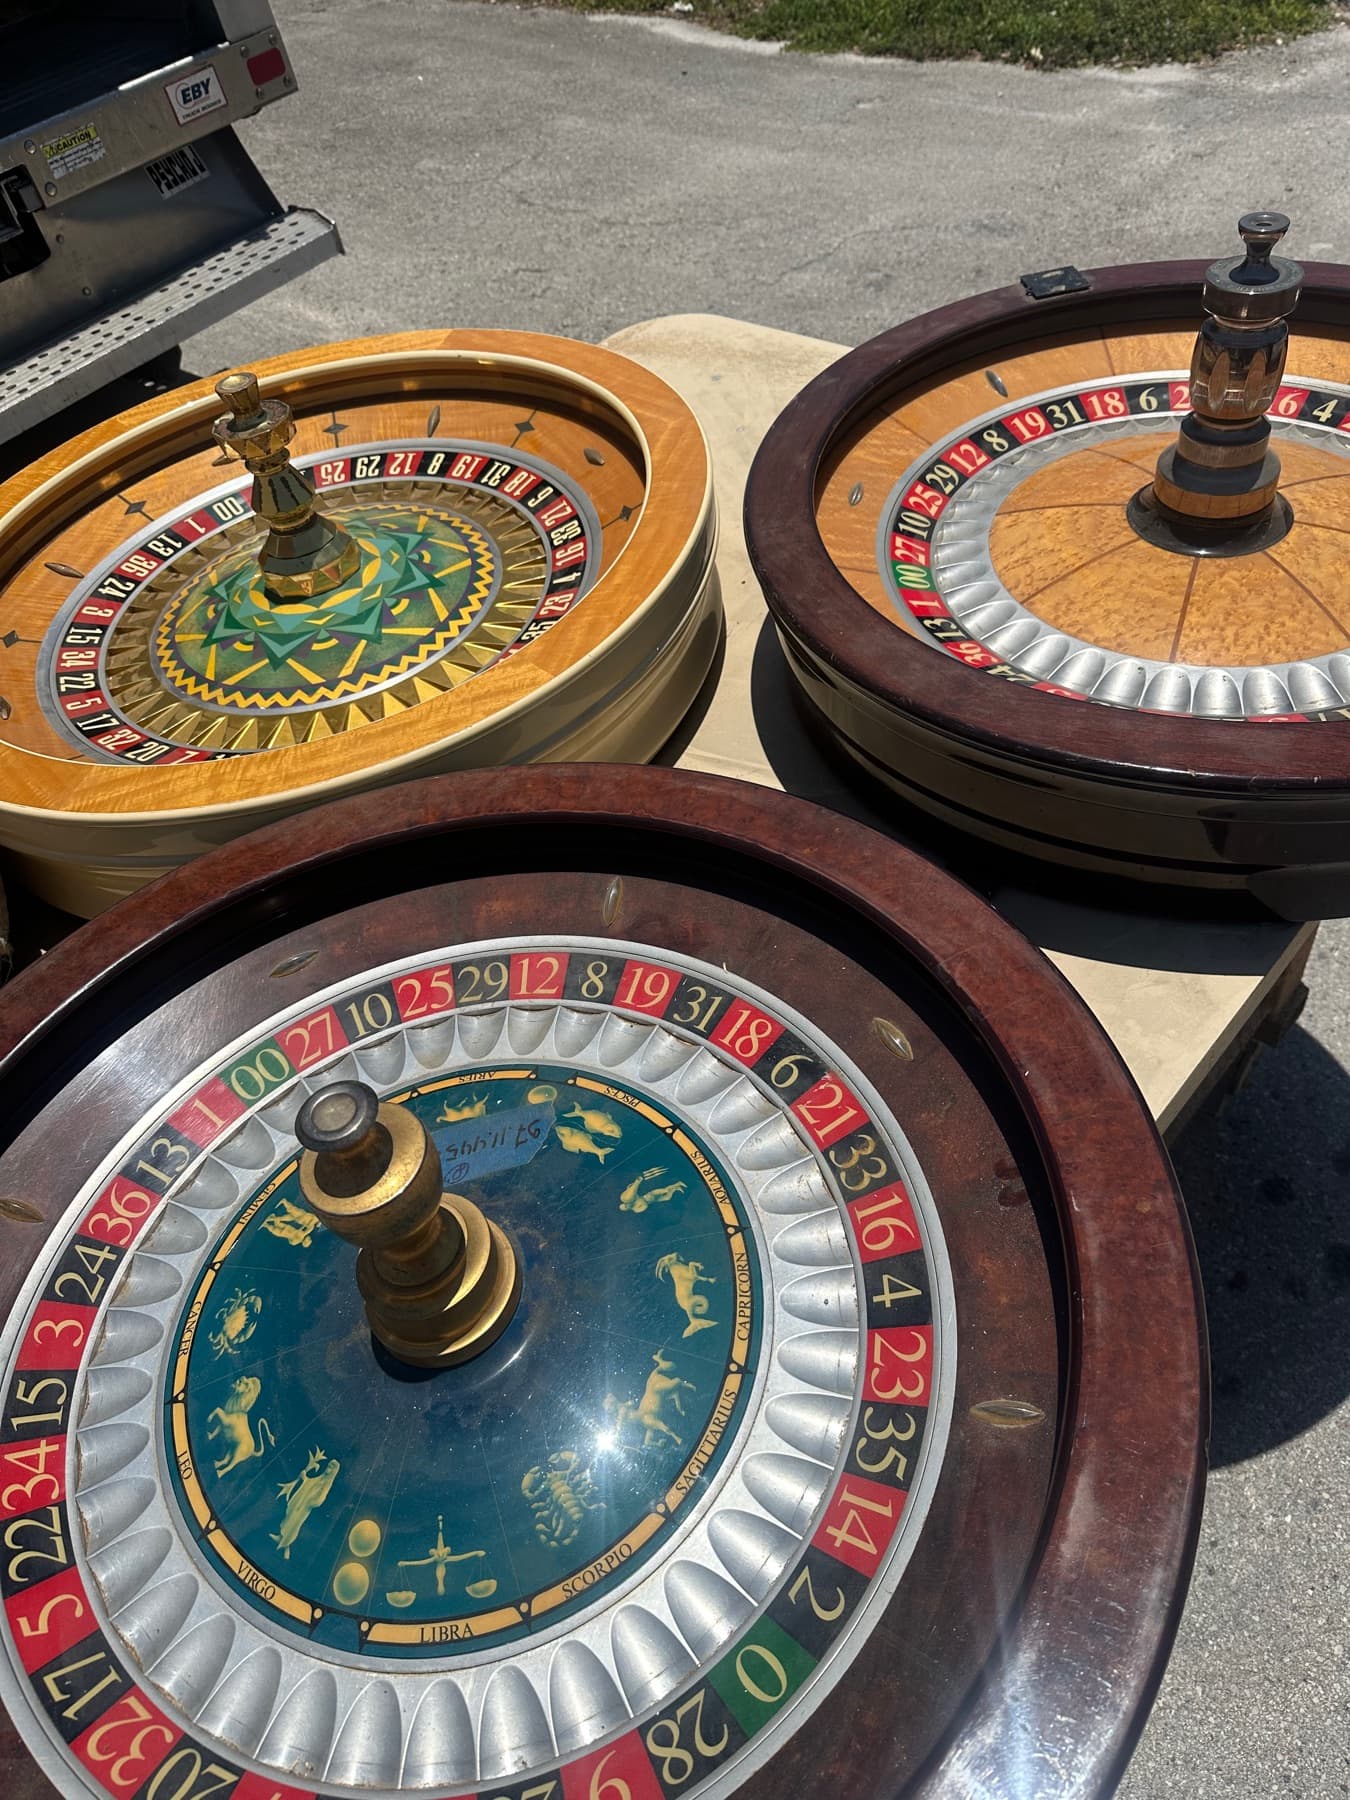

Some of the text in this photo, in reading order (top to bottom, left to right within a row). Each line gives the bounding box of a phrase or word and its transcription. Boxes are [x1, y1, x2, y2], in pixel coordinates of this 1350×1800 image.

[181, 77, 210, 105] EBY
[56, 131, 91, 151] CAUTION
[1087, 391, 1125, 419] 18
[1139, 387, 1158, 412] 6
[1173, 385, 1190, 410] 2
[1312, 400, 1338, 422] 4
[1010, 411, 1046, 441] 19
[1046, 400, 1087, 429] 31
[982, 429, 1009, 451] 8
[321, 461, 345, 485] 25
[355, 455, 381, 478] 29
[389, 453, 417, 475] 12
[427, 453, 446, 475] 8
[452, 455, 482, 479] 19
[950, 445, 988, 473] 12
[480, 461, 511, 487] 31
[504, 470, 537, 497] 18
[925, 464, 959, 495] 29
[212, 496, 244, 521] 00
[528, 486, 554, 508] 6
[908, 484, 943, 517] 25
[184, 516, 206, 534] 1
[541, 500, 573, 527] 21
[898, 512, 931, 540] 10
[148, 533, 182, 557] 13
[550, 520, 581, 546] 33
[556, 542, 584, 566] 16
[894, 536, 926, 566] 27
[120, 555, 158, 577] 36
[553, 572, 581, 584] 4
[896, 564, 930, 588] 00
[98, 577, 136, 599] 24
[81, 606, 114, 617] 3
[540, 593, 575, 615] 23
[908, 599, 942, 610] 1
[66, 627, 103, 644] 15
[923, 617, 967, 640] 13
[60, 651, 96, 667] 34
[947, 642, 999, 667] 36
[59, 673, 95, 692] 22
[66, 697, 103, 711] 5
[76, 713, 120, 731] 17
[97, 729, 141, 751] 32
[125, 742, 170, 762] 20
[457, 962, 509, 1003] 29
[514, 957, 560, 996] 12
[581, 961, 608, 998] 8
[621, 967, 670, 1008] 19
[398, 969, 454, 1018] 25
[346, 993, 393, 1038] 10
[673, 986, 722, 1033] 31
[285, 1012, 334, 1068] 27
[719, 1009, 772, 1058] 18
[231, 1048, 290, 1100] 00
[458, 1071, 497, 1085] ARIES
[770, 1054, 814, 1088] 6
[603, 1086, 641, 1107] PISCES
[192, 1099, 226, 1131] 1
[797, 1084, 858, 1143] 21
[136, 1138, 190, 1187] 13
[829, 1134, 888, 1191] 33
[690, 1150, 730, 1205] AQUARIUS
[88, 1182, 150, 1245] 36
[238, 1183, 276, 1225] GEMINI
[854, 1192, 916, 1250] 16
[54, 1244, 117, 1303] 24
[735, 1252, 752, 1341] CAPRICORN
[872, 1273, 923, 1308] 4
[33, 1319, 84, 1347] 3
[179, 1300, 203, 1357] CANCER
[871, 1331, 927, 1399] 23
[10, 1377, 68, 1432] 15
[675, 1389, 737, 1494] SAGITTARIUS
[856, 1406, 916, 1481] 35
[1, 1440, 60, 1511] 34
[176, 1450, 193, 1481] LEO
[825, 1484, 893, 1555] 14
[4, 1506, 68, 1582] 22
[236, 1561, 276, 1601] VIRGO
[562, 1543, 632, 1599] SCORPIO
[788, 1565, 845, 1621] 2
[16, 1593, 83, 1637] 5
[418, 1623, 474, 1643] LIBRA
[43, 1651, 122, 1721] 17
[735, 1644, 787, 1703] 0
[87, 1696, 174, 1786] 32
[646, 1688, 729, 1785] 28
